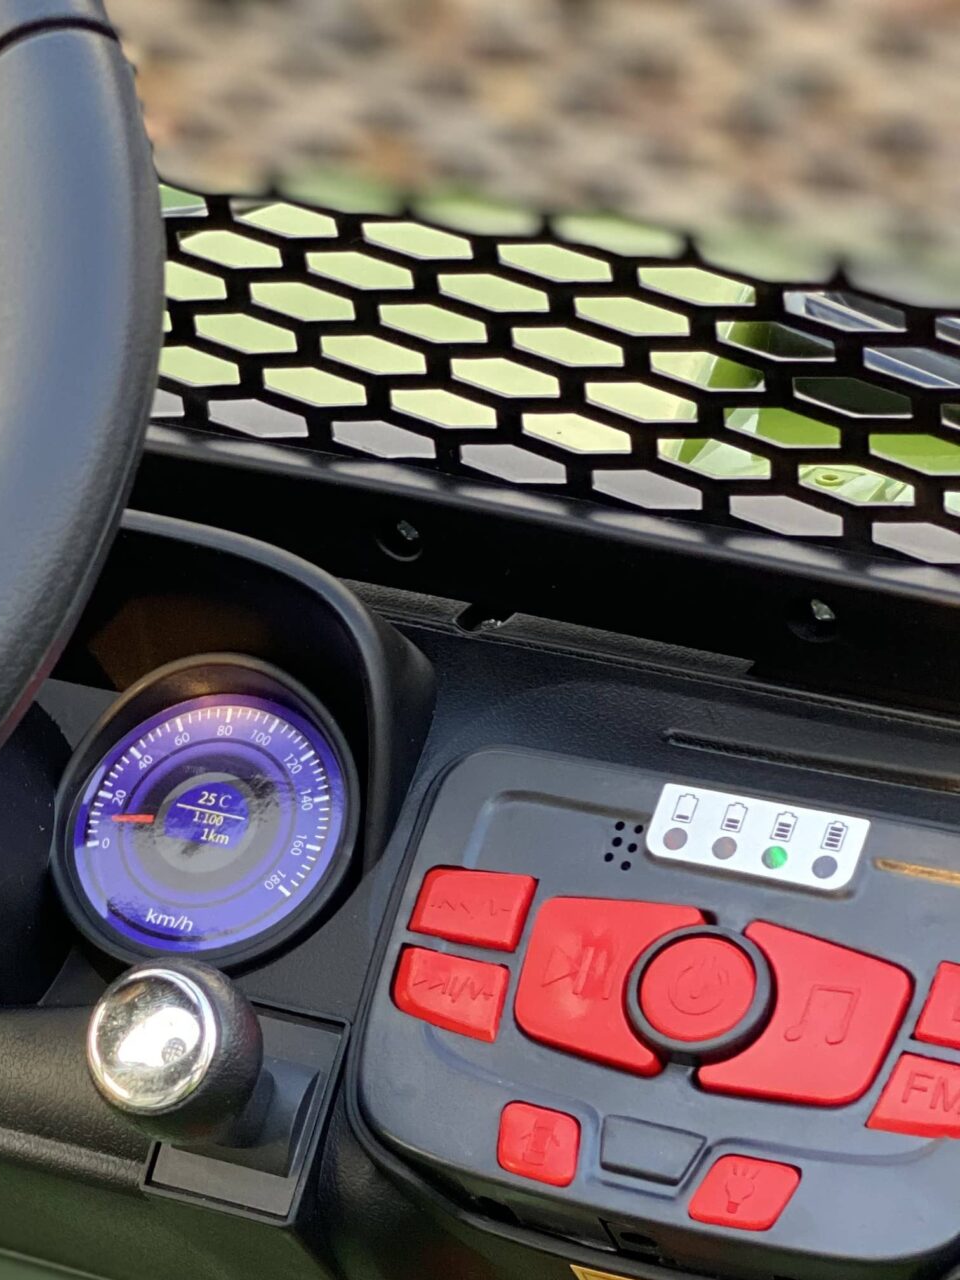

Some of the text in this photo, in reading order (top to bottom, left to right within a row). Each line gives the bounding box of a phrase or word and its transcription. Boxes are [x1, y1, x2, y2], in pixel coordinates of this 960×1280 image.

[174, 732, 191, 746] 60
[217, 724, 233, 737] 80
[250, 729, 272, 747] 100
[138, 754, 154, 770] 40
[282, 753, 303, 775] 120
[112, 789, 127, 804] 20
[198, 791, 218, 806] 25
[299, 788, 314, 811] 140
[101, 837, 111, 849] 0
[200, 828, 230, 845] 1km
[290, 834, 308, 856] 160
[264, 869, 286, 891] 180
[145, 908, 195, 933] km/h
[901, 1071, 960, 1117] FM
